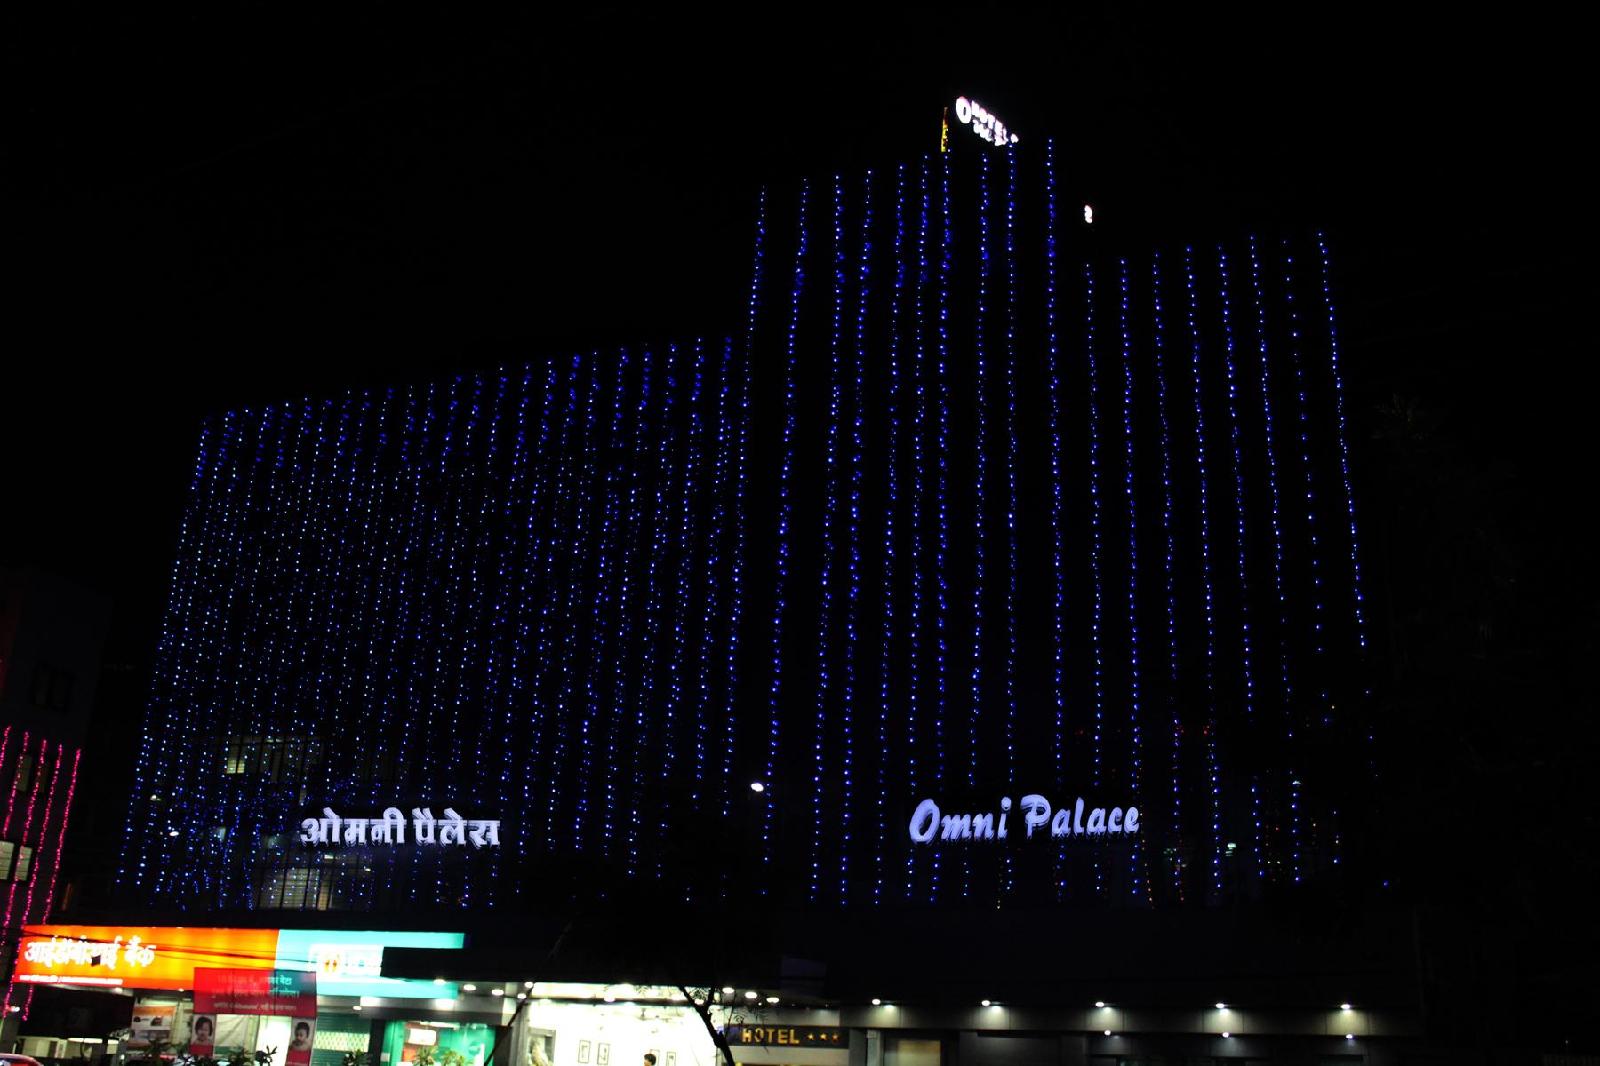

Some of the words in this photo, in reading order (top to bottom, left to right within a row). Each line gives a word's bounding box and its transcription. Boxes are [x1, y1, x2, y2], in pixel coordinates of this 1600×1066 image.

[300, 807, 407, 847] ओमनी
[412, 807, 500, 849] पैलेस
[909, 798, 1012, 845] Omni
[1020, 794, 1140, 839] Palace
[741, 1027, 800, 1044] HOTEL
